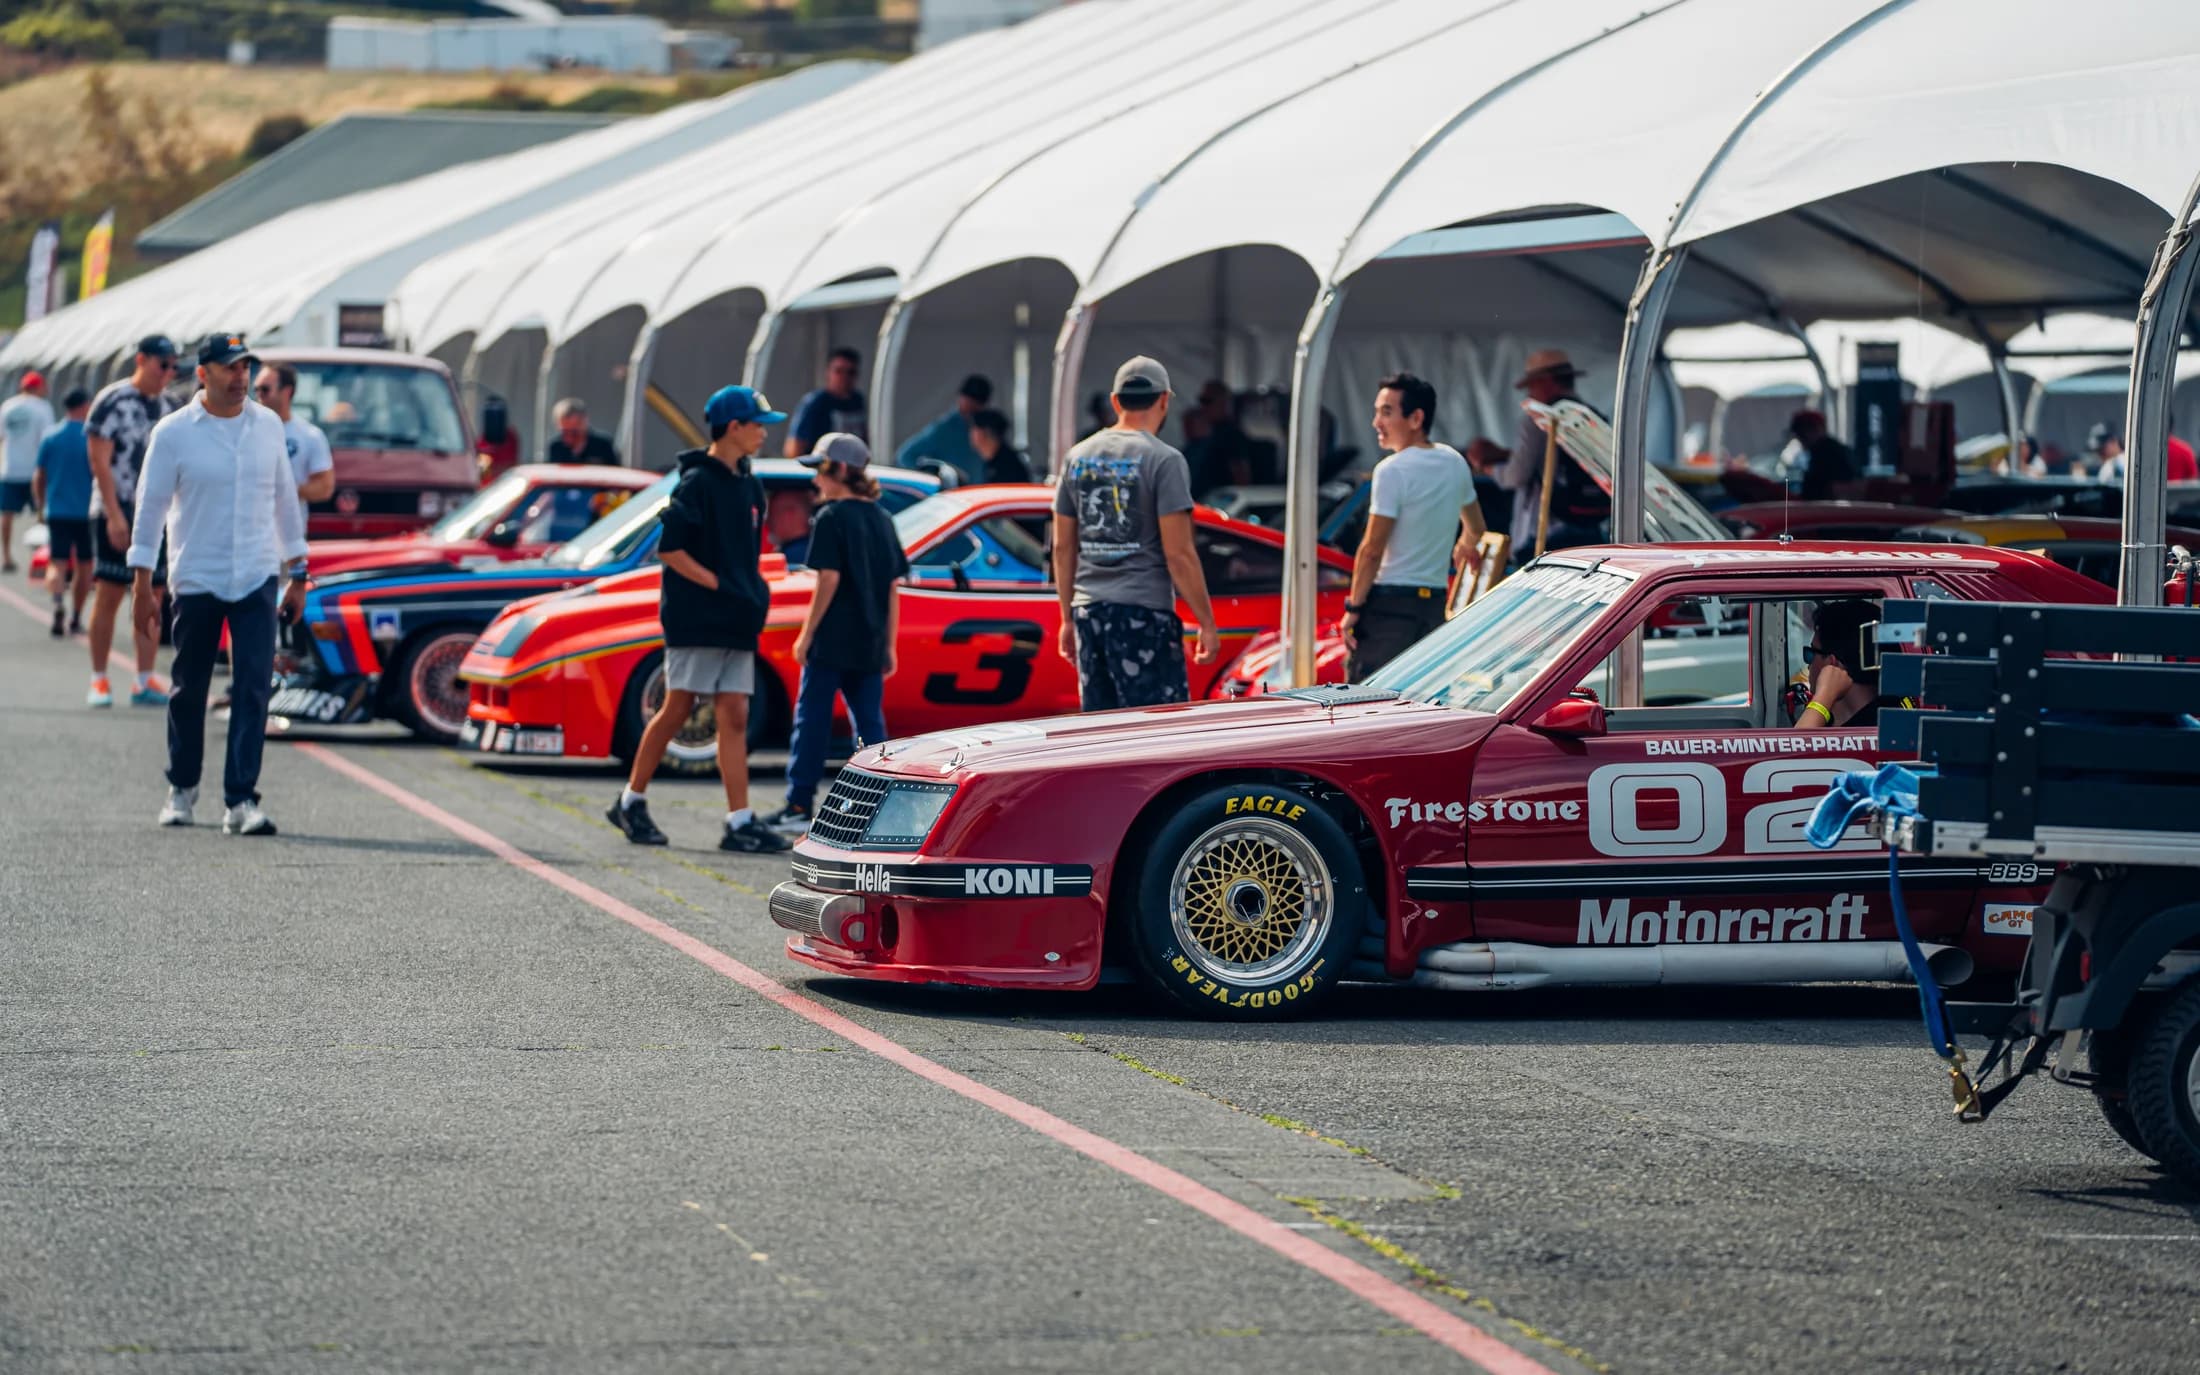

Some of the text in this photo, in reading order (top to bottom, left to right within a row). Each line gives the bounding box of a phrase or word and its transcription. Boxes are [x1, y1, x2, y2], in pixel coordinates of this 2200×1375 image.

[1672, 550, 1963, 569] Firestone
[923, 618, 1043, 705] 3
[1225, 796, 1307, 821] EAGLE
[1384, 797, 1581, 829] Firestone
[855, 864, 890, 892] Hella
[965, 868, 1054, 894] KONI
[1989, 863, 2039, 882] BBS
[1577, 893, 1870, 944] Motorcraft
[1171, 955, 1315, 1008] GOODYEAR
